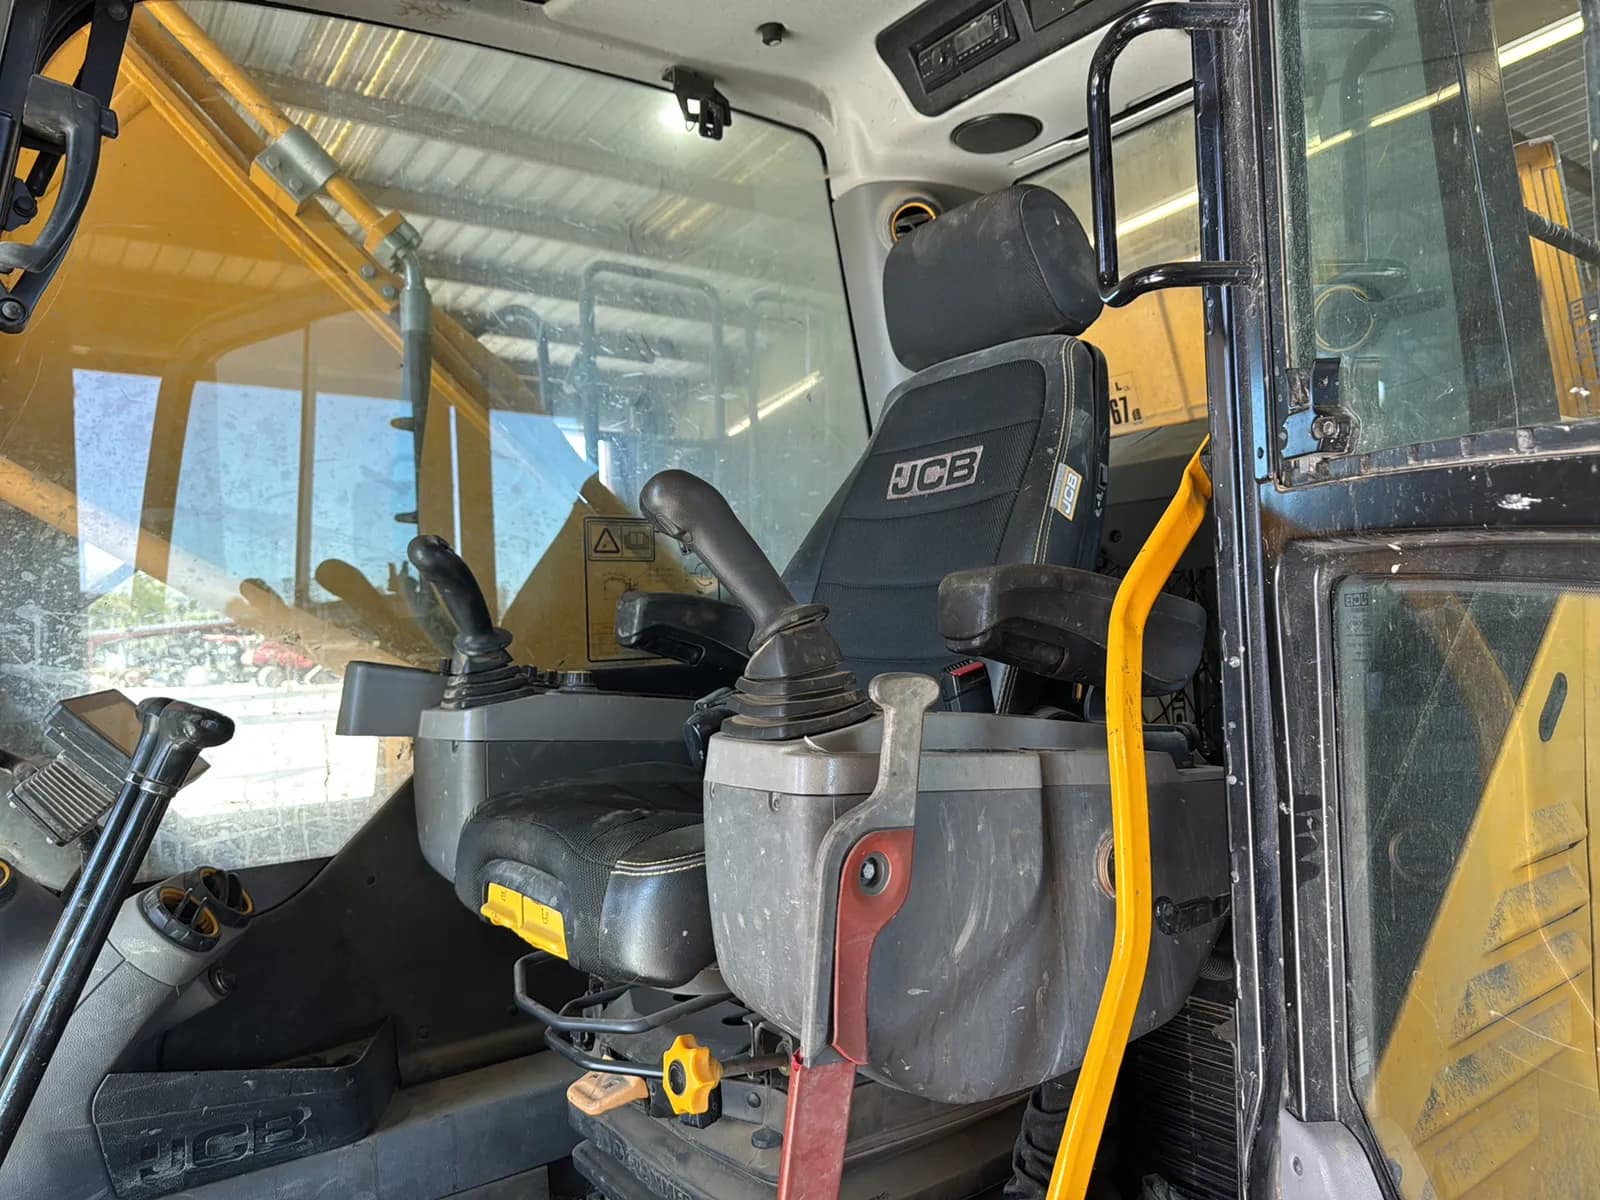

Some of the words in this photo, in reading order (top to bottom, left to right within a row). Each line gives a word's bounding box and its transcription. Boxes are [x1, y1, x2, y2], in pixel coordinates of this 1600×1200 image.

[889, 449, 980, 496] JCB
[1060, 470, 1080, 516] JCB
[137, 1106, 313, 1182] JCB
